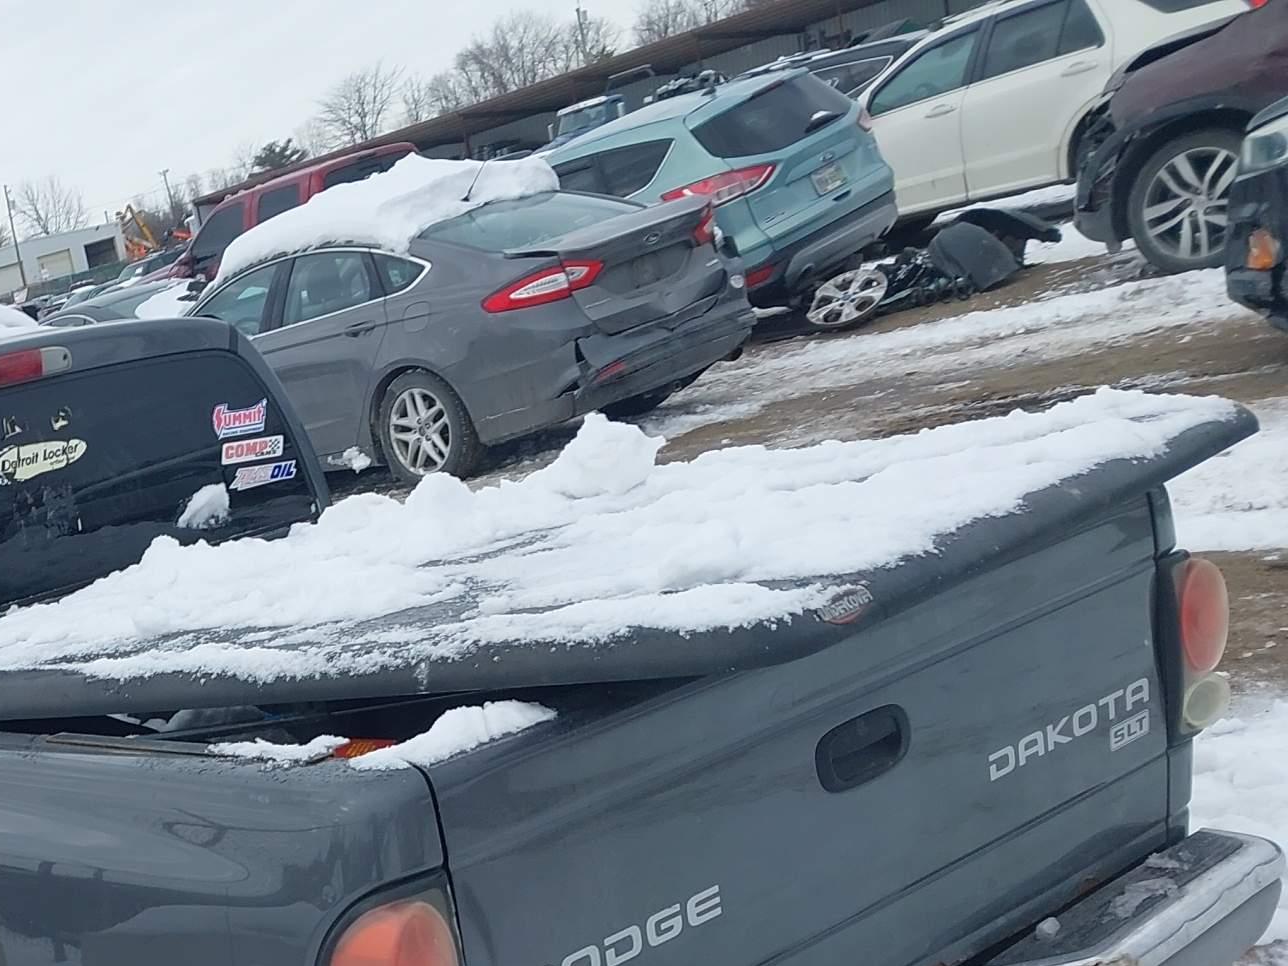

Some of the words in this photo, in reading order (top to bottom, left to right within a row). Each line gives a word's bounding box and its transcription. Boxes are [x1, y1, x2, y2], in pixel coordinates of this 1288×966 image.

[43, 443, 78, 461] Locker
[225, 441, 268, 459] COMP
[988, 677, 1149, 782] DAKOTA
[1113, 716, 1146, 744] SLT
